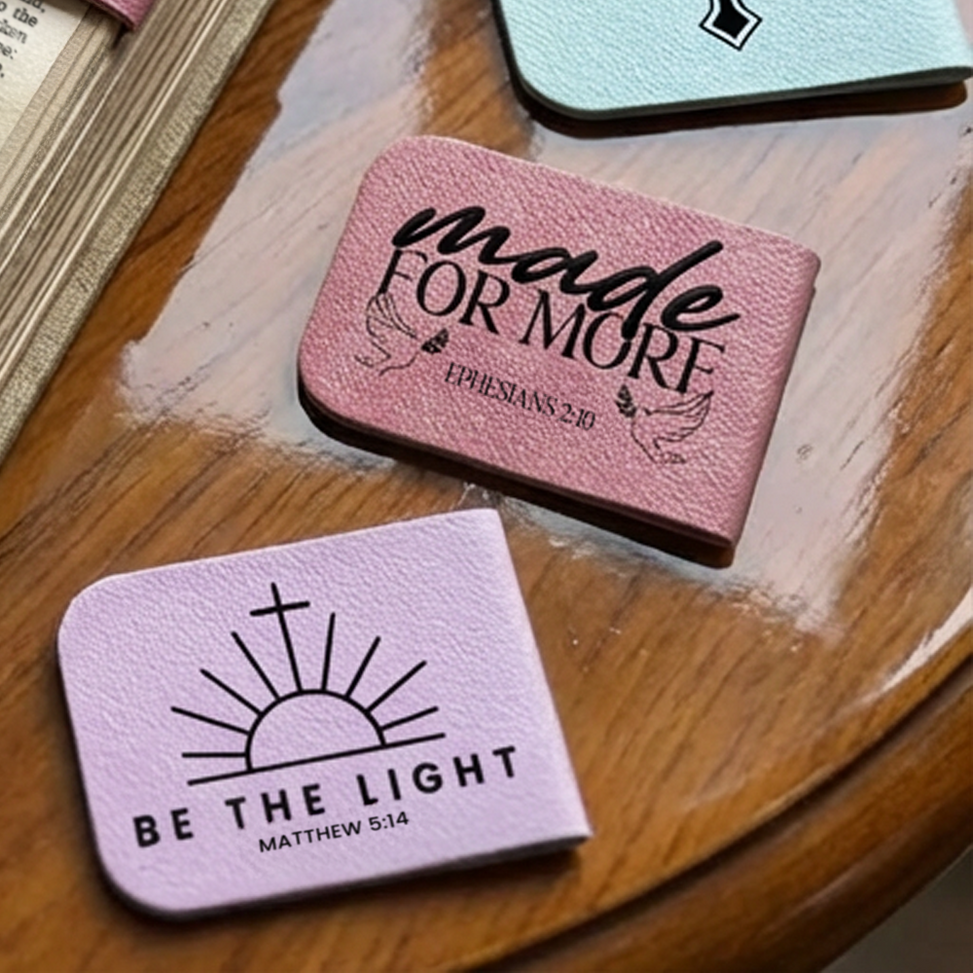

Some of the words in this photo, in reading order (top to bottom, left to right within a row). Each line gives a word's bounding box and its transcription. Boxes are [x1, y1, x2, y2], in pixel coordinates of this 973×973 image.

[378, 248, 511, 334] FOR
[391, 206, 740, 339] made
[444, 362, 557, 418] EPHESIANS
[560, 402, 597, 431] 2:10
[132, 807, 194, 848] BE
[224, 783, 327, 830] THE
[356, 745, 517, 807] LIGHT
[258, 819, 363, 853] MATTHEW
[368, 810, 410, 833] 5:14
